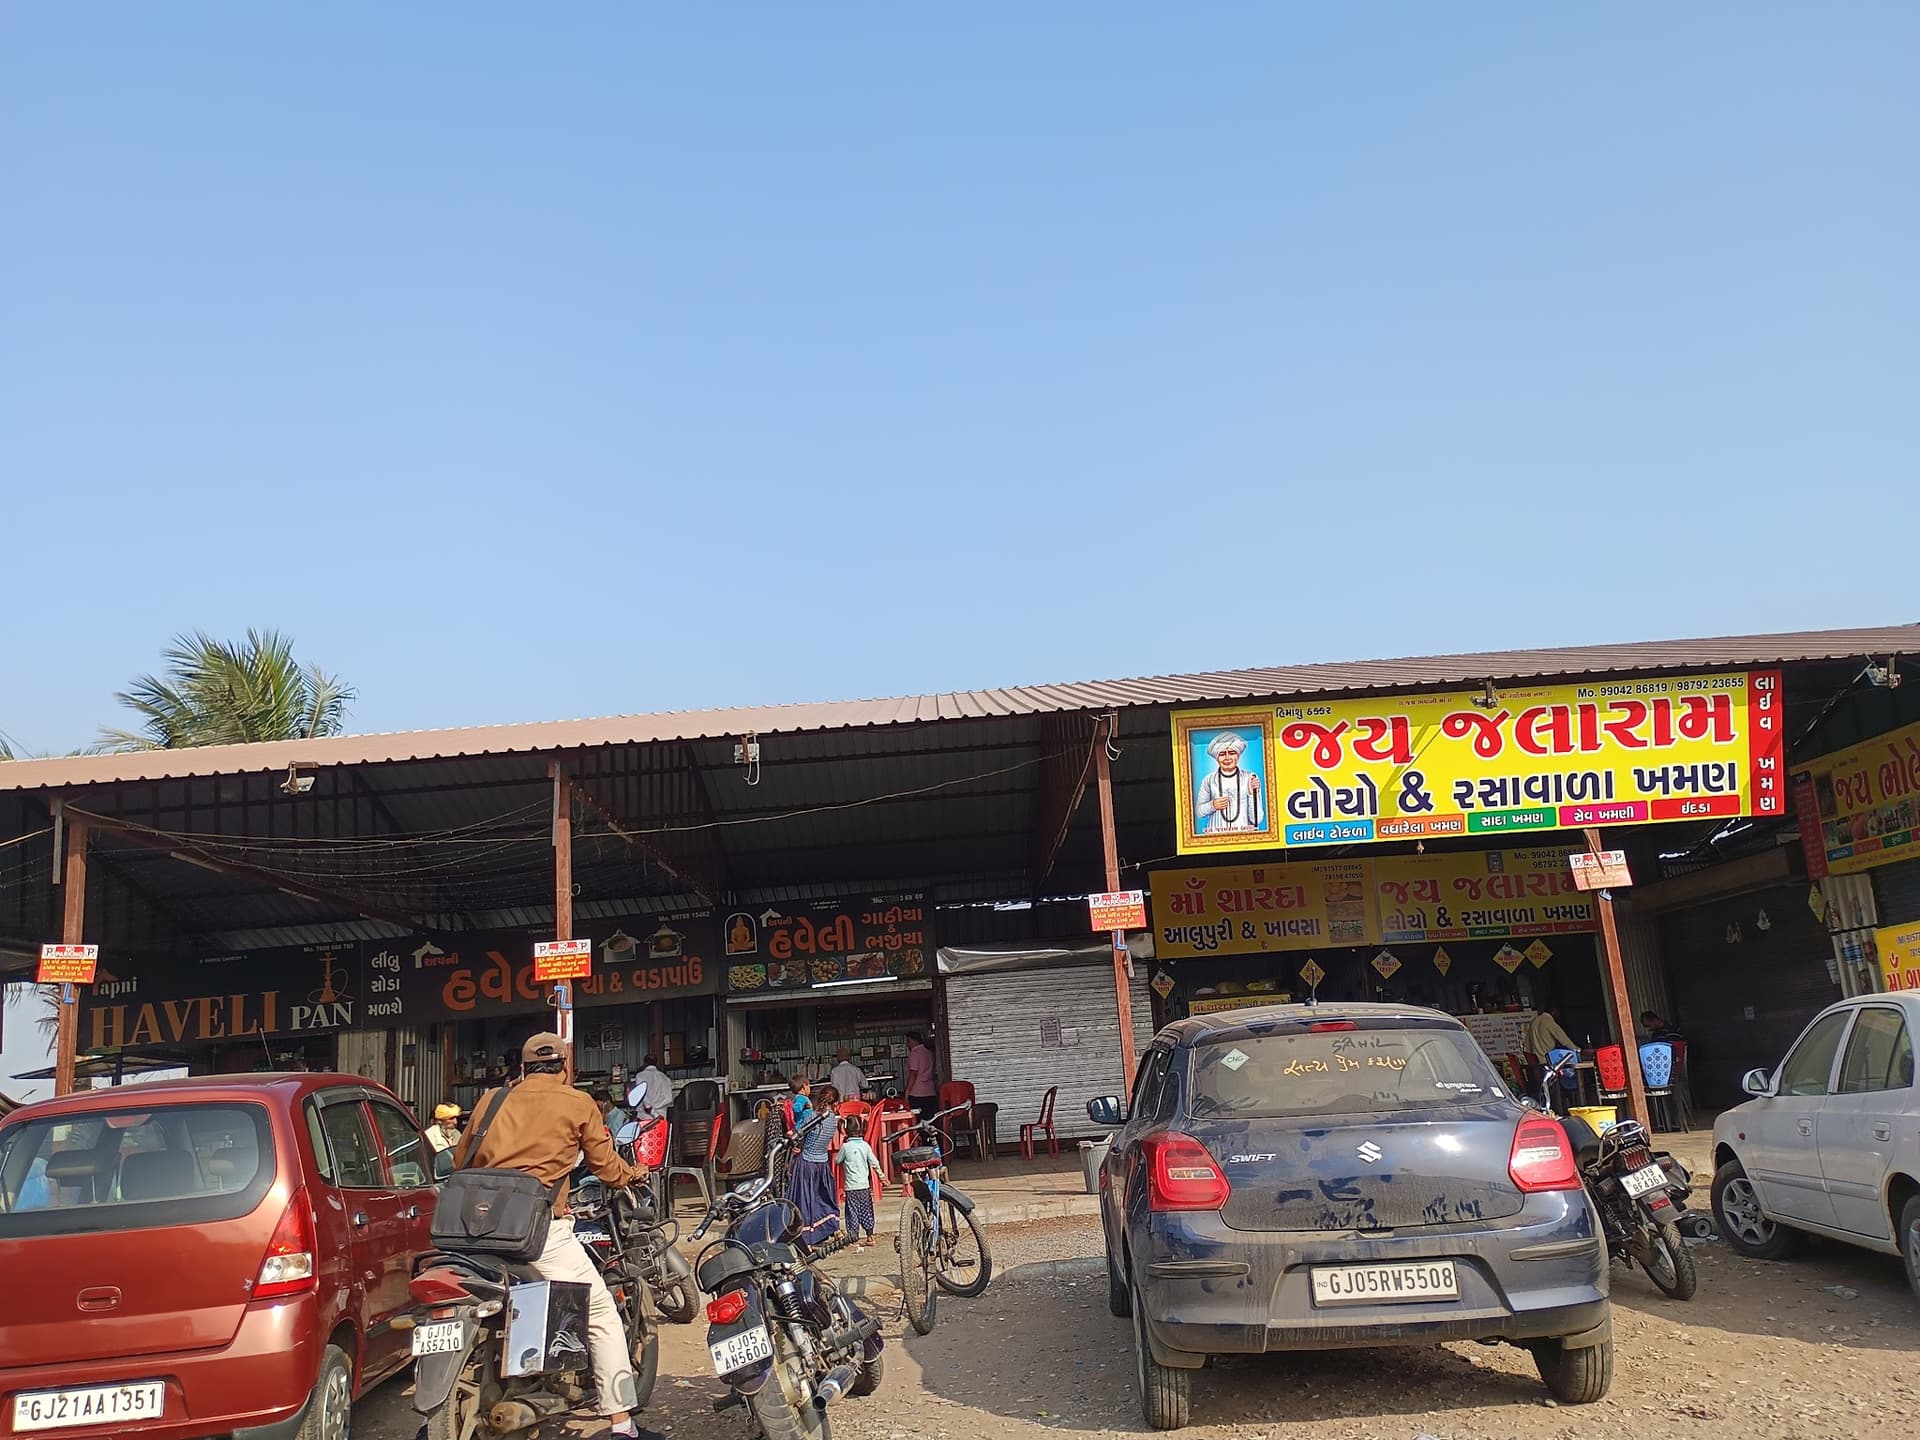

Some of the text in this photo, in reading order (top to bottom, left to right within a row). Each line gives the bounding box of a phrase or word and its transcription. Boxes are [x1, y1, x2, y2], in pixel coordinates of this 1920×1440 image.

[1578, 688, 1597, 698] Mo.
[1601, 686, 1632, 697] 99042
[1636, 683, 1667, 694] 86819
[1677, 679, 1709, 691] 98792
[1712, 677, 1744, 689] 23655
[1281, 694, 1736, 769] જય જલારામ
[1287, 762, 1737, 818] લોચો & રસાવાળા ખમણ
[1835, 771, 1873, 810] જય
[1429, 819, 1462, 832] ખમણ
[1480, 812, 1544, 827] સાદા ખમણ
[1573, 806, 1635, 822] સેવ ખમણી
[1329, 824, 1367, 838] ઢોકળા
[1217, 884, 1308, 913] શારદા
[1380, 879, 1442, 905] જય
[1385, 903, 1591, 930] લોચો & રસાવાળા ખમણ
[769, 915, 856, 959] હવેલી
[1163, 917, 1233, 951] આલુપુરી
[1241, 920, 1257, 940] &
[1263, 918, 1321, 937] ખાવસા
[370, 974, 400, 993] સોડા
[610, 971, 624, 992] &
[289, 1001, 355, 1031] PAN
[368, 996, 402, 1016] મળશે
[88, 991, 280, 1049] HAVELI
[1226, 1055, 1244, 1063] CNG
[1229, 1153, 1277, 1163] SWIFT
[1632, 1167, 1655, 1183] GJ19
[1330, 1267, 1454, 1295] GJ05RW5508
[427, 1324, 453, 1340] GJ10
[727, 1331, 758, 1354] GJ05
[420, 1337, 460, 1353] AS5210
[725, 1342, 768, 1371] AN5600
[30, 1387, 156, 1422] GJ21AA1351
